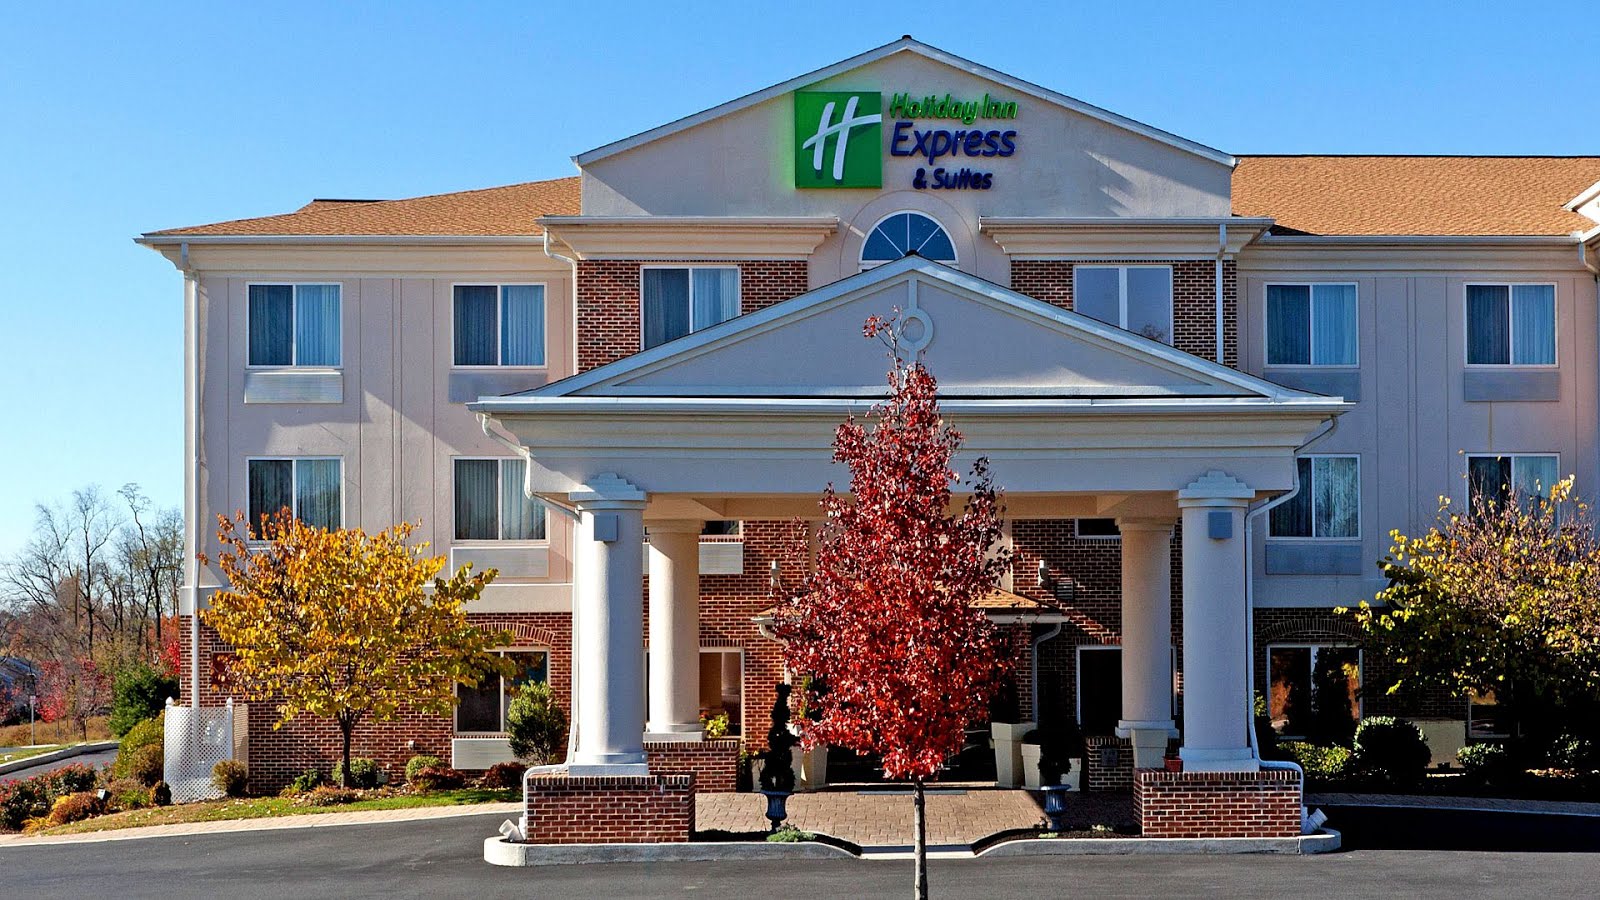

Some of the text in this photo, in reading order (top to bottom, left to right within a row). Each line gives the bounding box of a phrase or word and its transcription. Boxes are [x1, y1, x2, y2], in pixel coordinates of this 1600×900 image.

[889, 92, 1018, 124] Holiday Inn
[803, 96, 881, 180] H
[890, 121, 1017, 165] Express
[913, 167, 993, 190] & Suites
